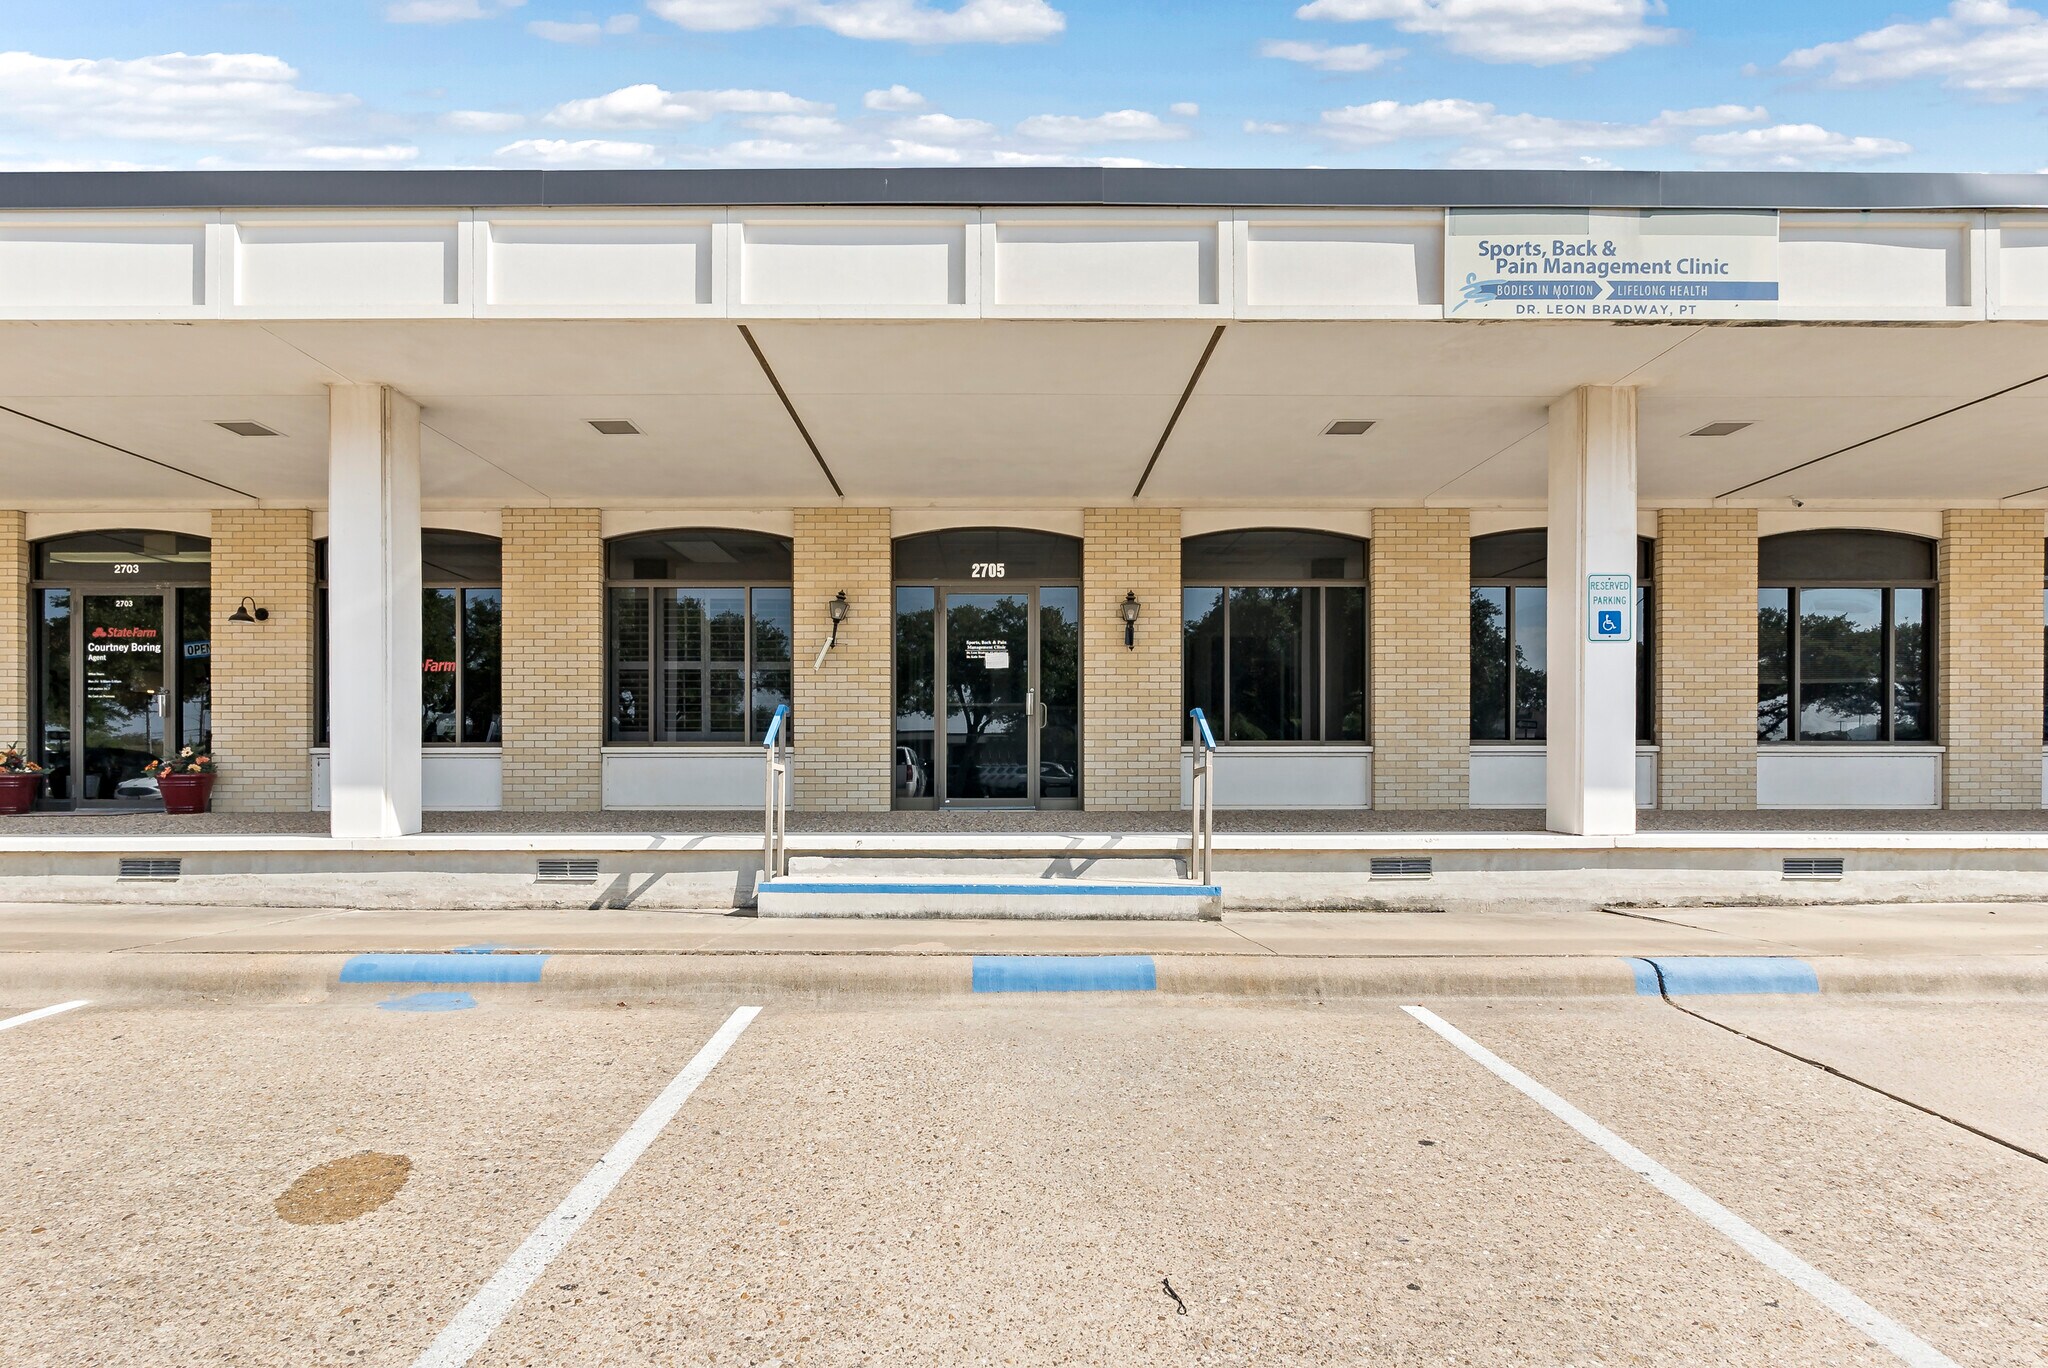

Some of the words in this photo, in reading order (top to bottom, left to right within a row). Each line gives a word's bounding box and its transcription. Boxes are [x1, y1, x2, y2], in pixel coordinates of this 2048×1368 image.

[1478, 240, 1547, 260] Sports,
[1552, 239, 1597, 256] Back
[1601, 240, 1617, 257] &
[1496, 257, 1538, 274] Pain
[1543, 257, 1672, 278] Management
[1676, 257, 1729, 275] Clinic
[1496, 284, 1534, 296] BODIES
[1538, 284, 1549, 296] IN
[1552, 284, 1593, 296] MOTION
[1617, 285, 1666, 296] LIFELONG
[1669, 285, 1708, 297] HEALTH
[1516, 304, 1540, 315] DR.
[1546, 304, 1586, 315] LEON
[1592, 304, 1673, 316] BRADWAY,
[1679, 304, 1697, 315] PT
[113, 564, 140, 574] 2703
[971, 562, 1005, 578] 2705
[1590, 581, 1629, 590] RESERVED
[115, 600, 134, 608] 2703
[1593, 596, 1627, 605] PARKING
[87, 642, 129, 654] Courtney
[131, 642, 162, 654] Boring
[87, 654, 107, 662] Agent
[421, 659, 456, 672] Farm
